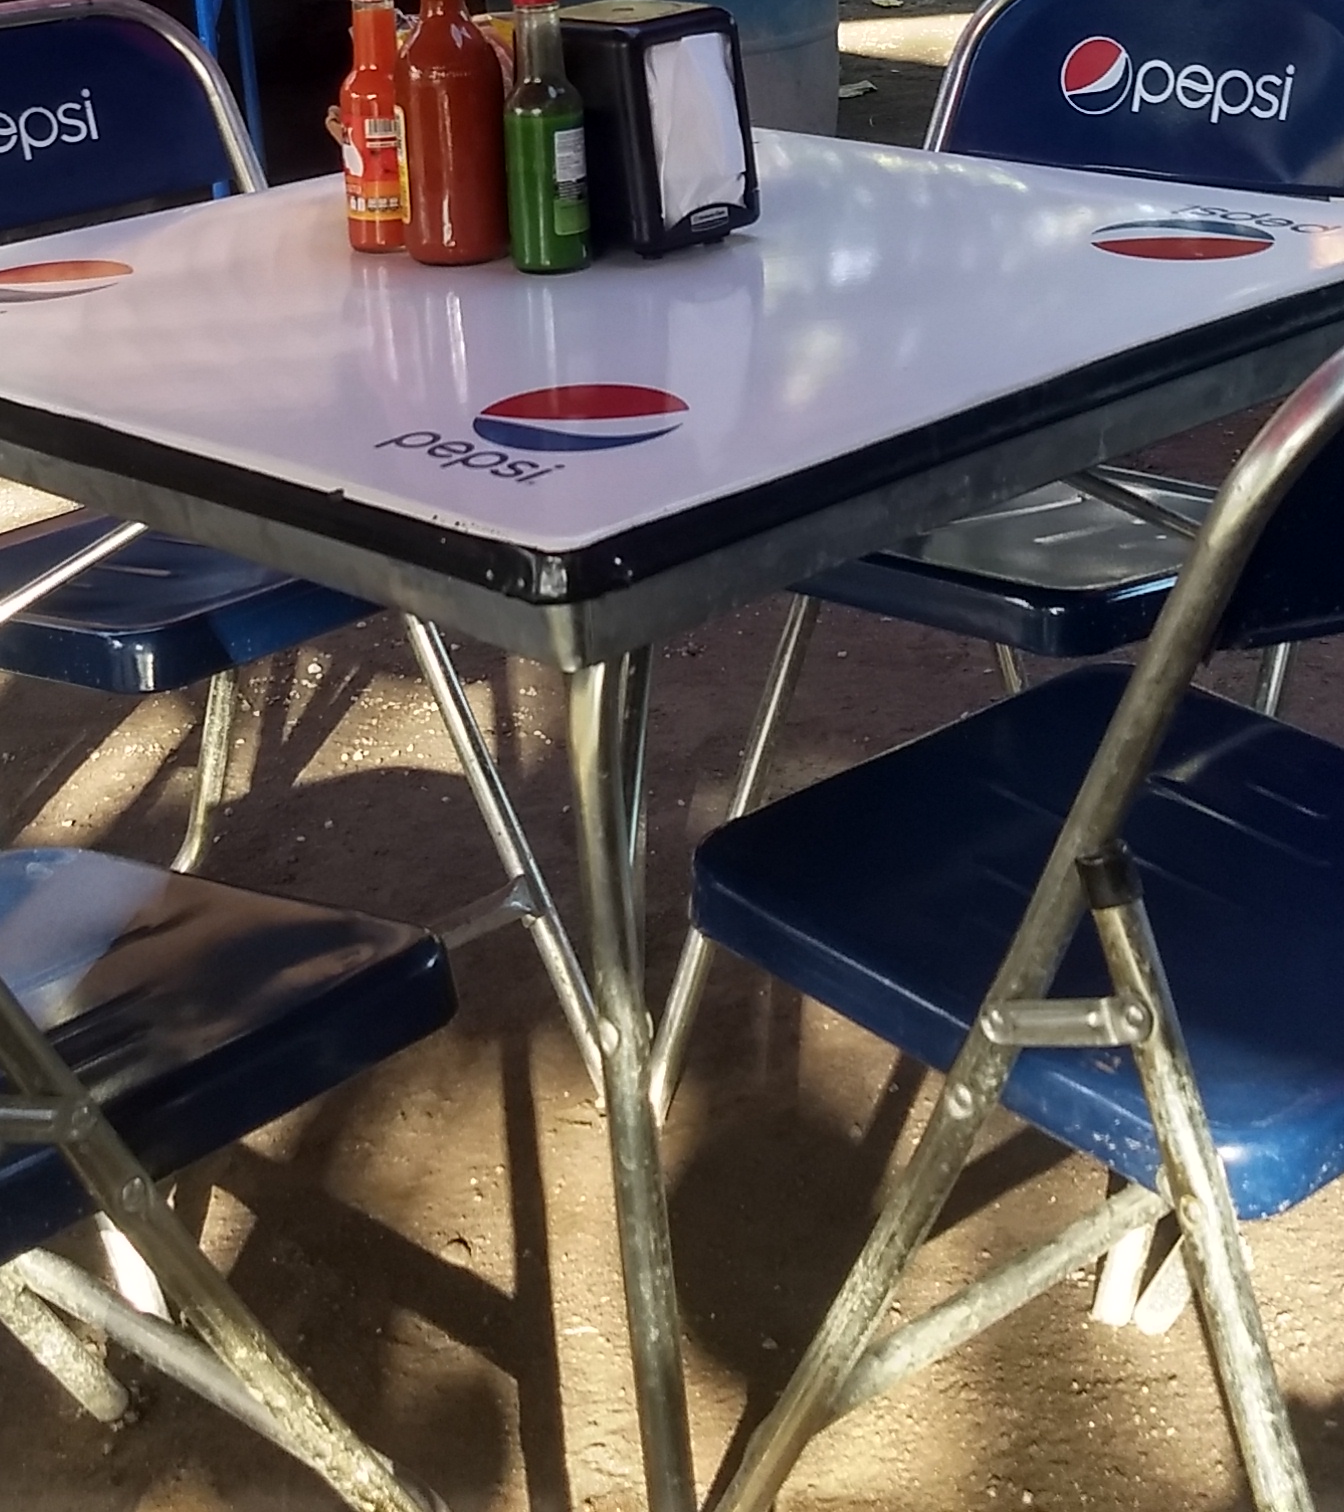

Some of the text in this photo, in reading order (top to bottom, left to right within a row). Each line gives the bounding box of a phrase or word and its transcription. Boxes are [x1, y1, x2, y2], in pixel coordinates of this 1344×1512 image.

[1131, 59, 1296, 124] pepsi
[1170, 204, 1343, 234] pepsi
[374, 431, 566, 484] pepsi
